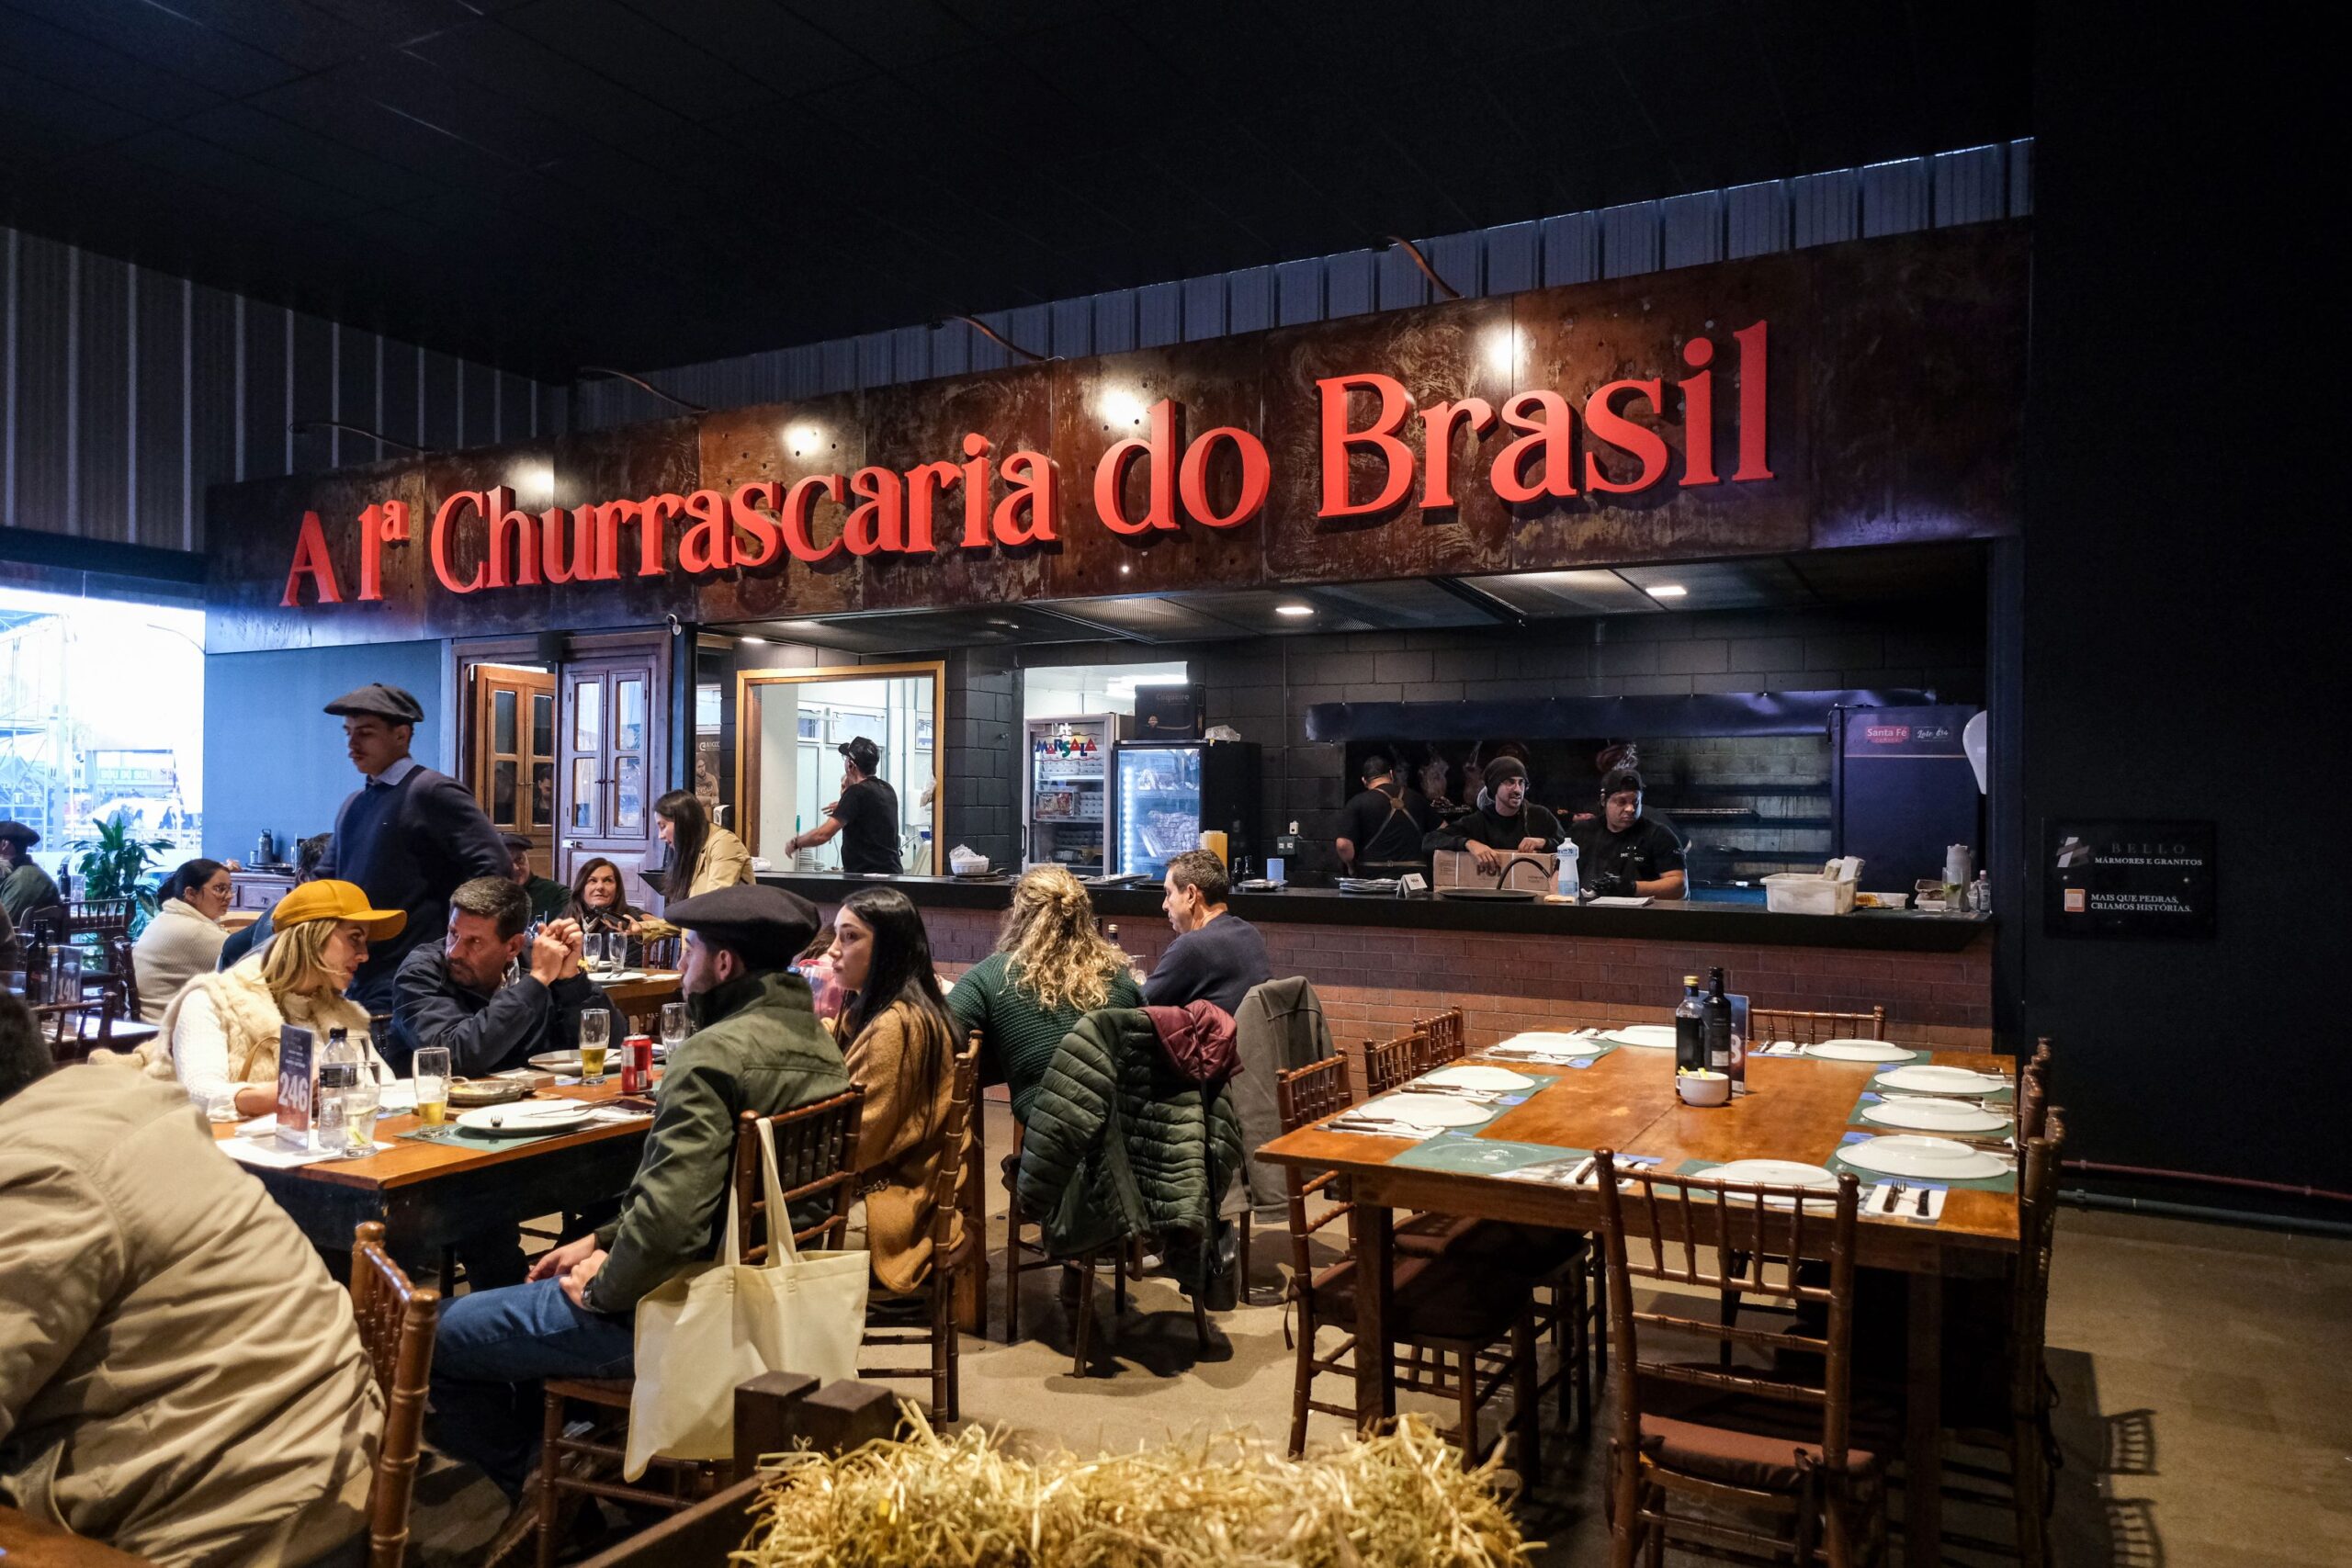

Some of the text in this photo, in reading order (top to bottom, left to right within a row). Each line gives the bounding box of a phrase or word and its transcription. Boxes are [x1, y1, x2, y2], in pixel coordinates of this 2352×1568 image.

[279, 511, 343, 607] A
[430, 433, 1060, 594] Churrascaria
[1093, 398, 1271, 535] do
[1316, 320, 1774, 518] Brasil
[1867, 728, 1894, 737] Santa
[1035, 738, 1098, 758] MARSALA
[2112, 843, 2185, 854] BELLO
[2095, 856, 2145, 865] MÁRMORES
[2154, 858, 2203, 866] GRANITOS
[2090, 894, 2115, 902] MAIS
[2116, 894, 2138, 903] QUE
[2090, 902, 2135, 911] CRIAMOS
[278, 1071, 309, 1112] 246
